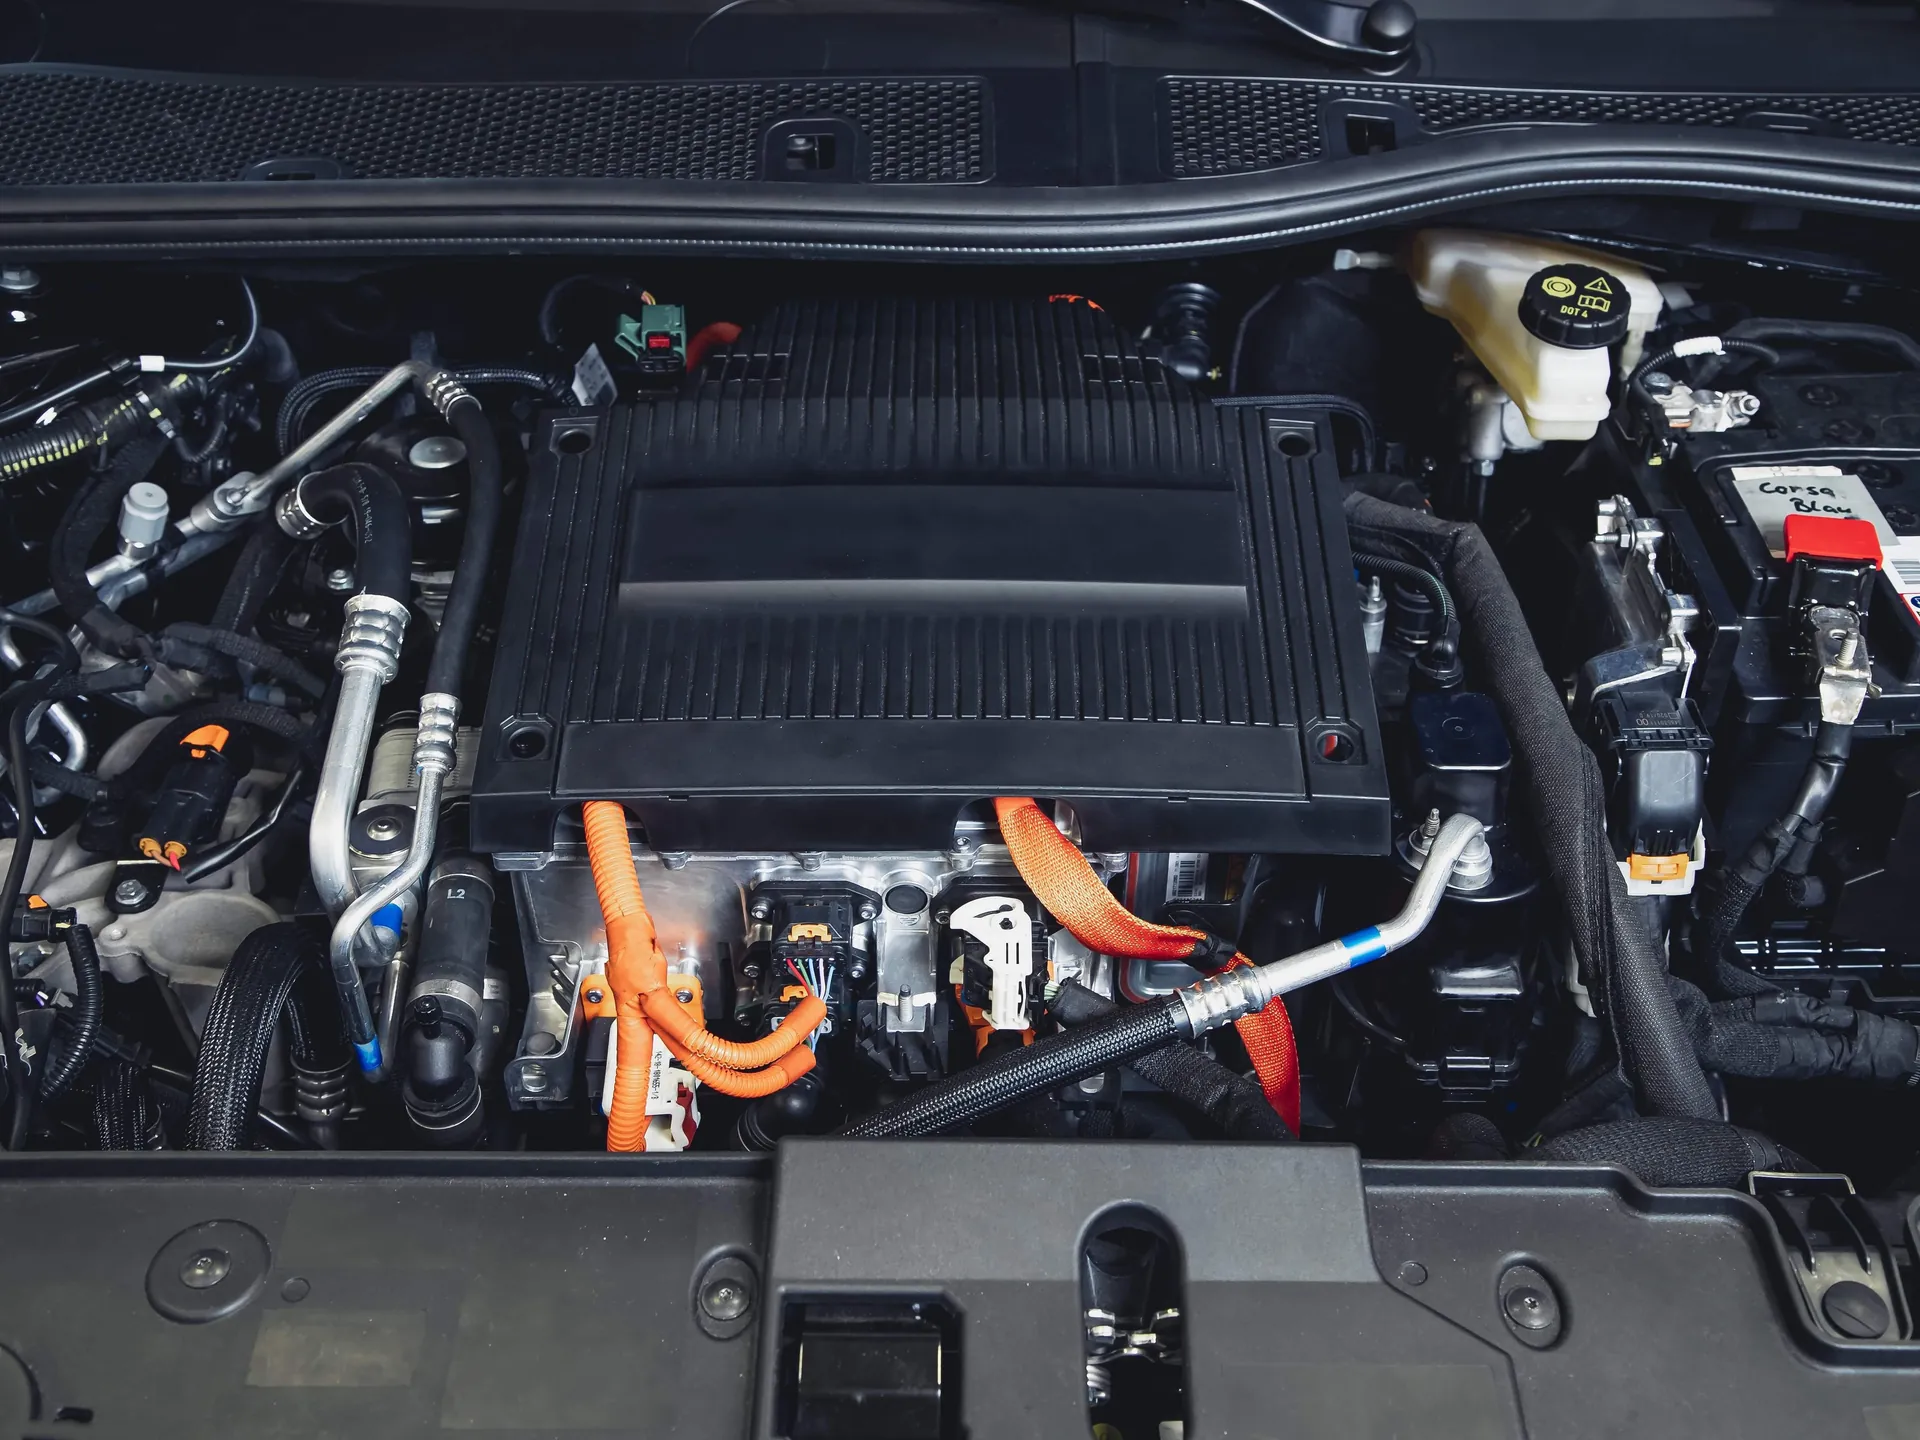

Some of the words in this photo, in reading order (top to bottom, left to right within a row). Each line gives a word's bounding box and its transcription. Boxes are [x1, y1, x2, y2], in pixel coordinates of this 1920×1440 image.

[1560, 305, 1581, 317] DOT
[1581, 310, 1589, 318] 4
[1759, 482, 1836, 499] Corsa
[1789, 497, 1853, 513] Blau
[446, 888, 466, 899] L2
